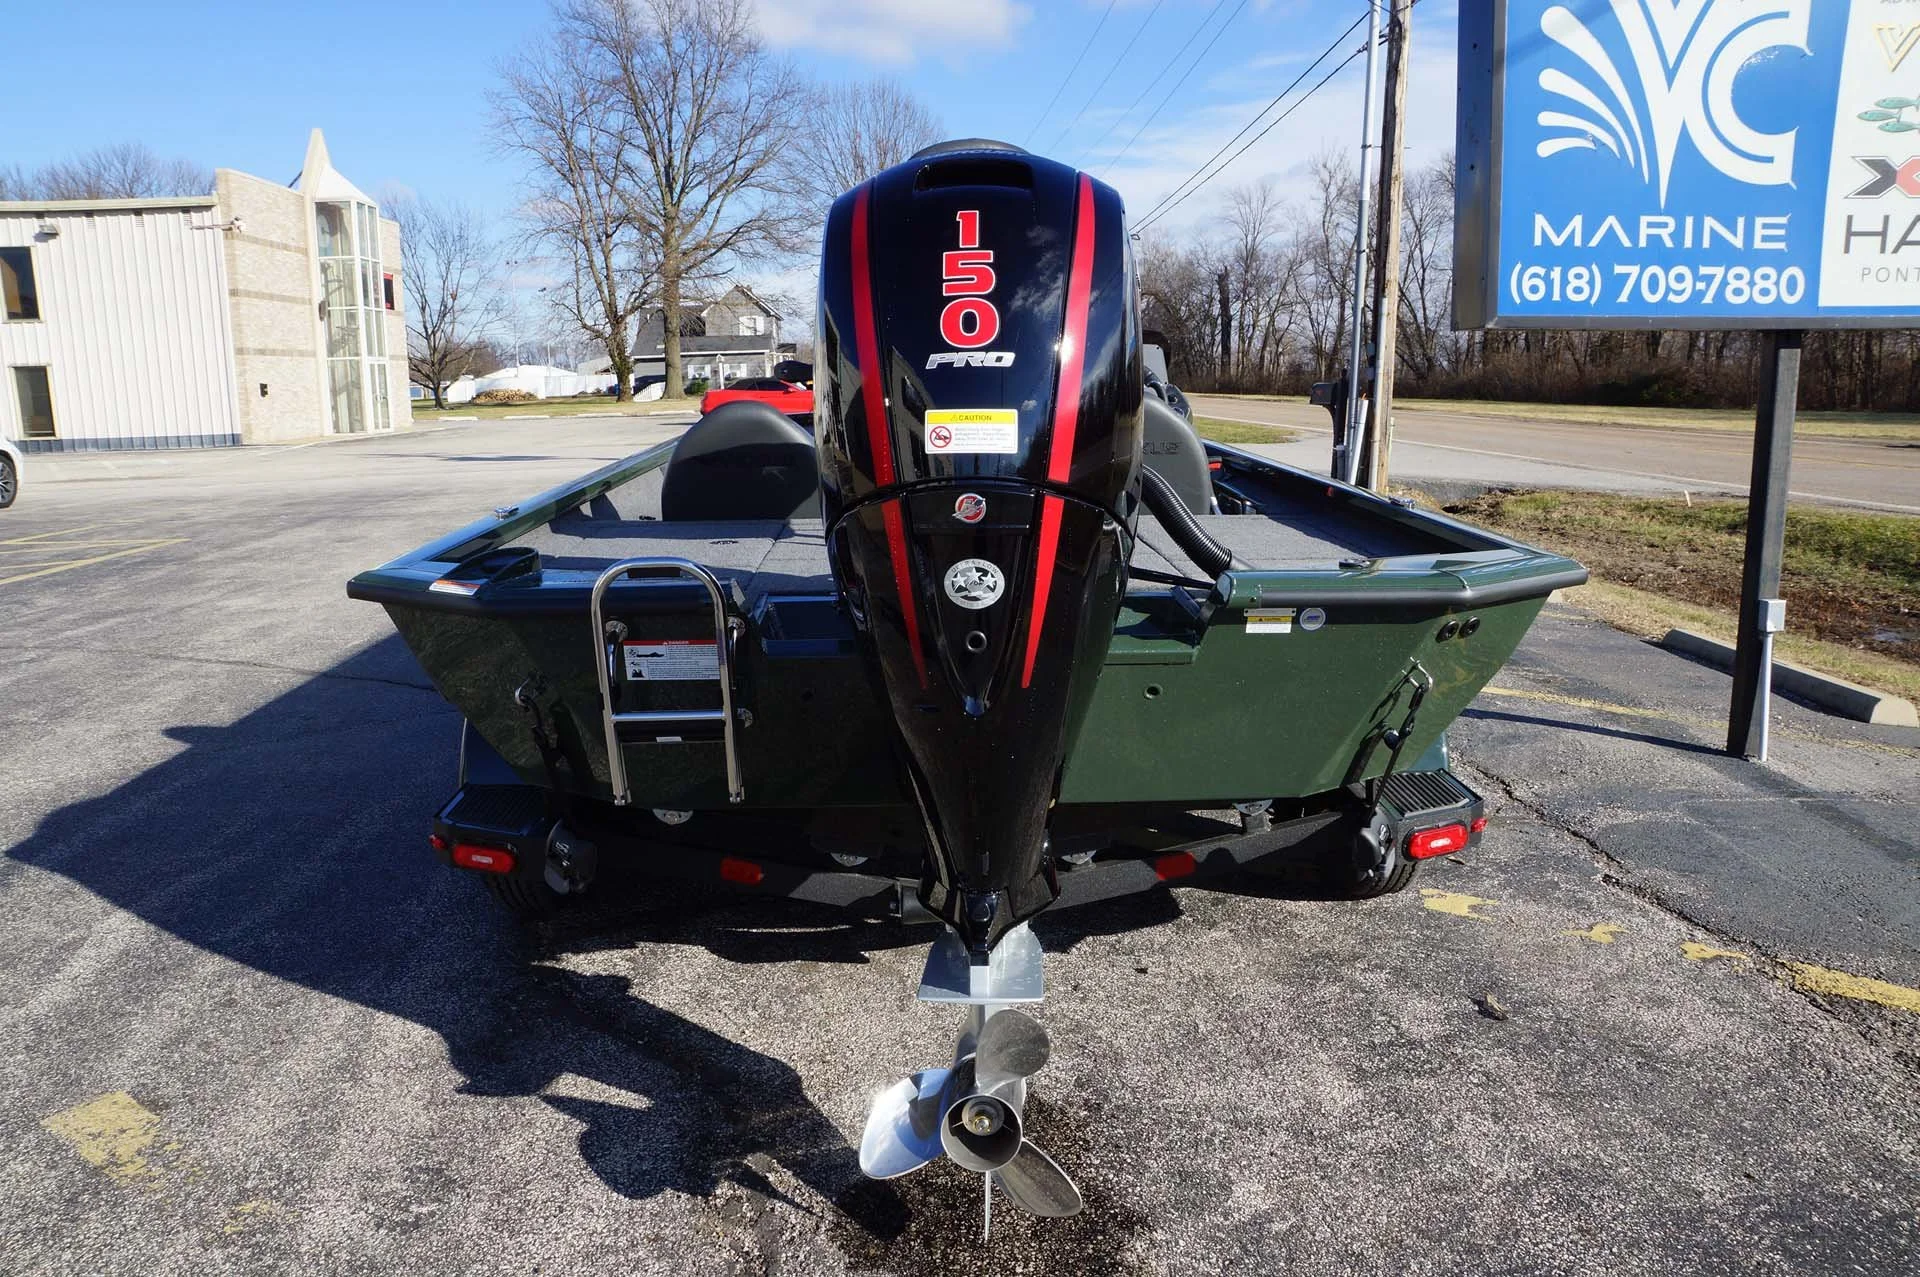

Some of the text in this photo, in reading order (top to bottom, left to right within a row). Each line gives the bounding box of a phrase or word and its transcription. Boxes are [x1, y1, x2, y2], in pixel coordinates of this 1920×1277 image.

[1533, 212, 1792, 252] MARINE
[1510, 261, 1806, 306] (618) 709-7880
[925, 351, 1016, 369] PRO
